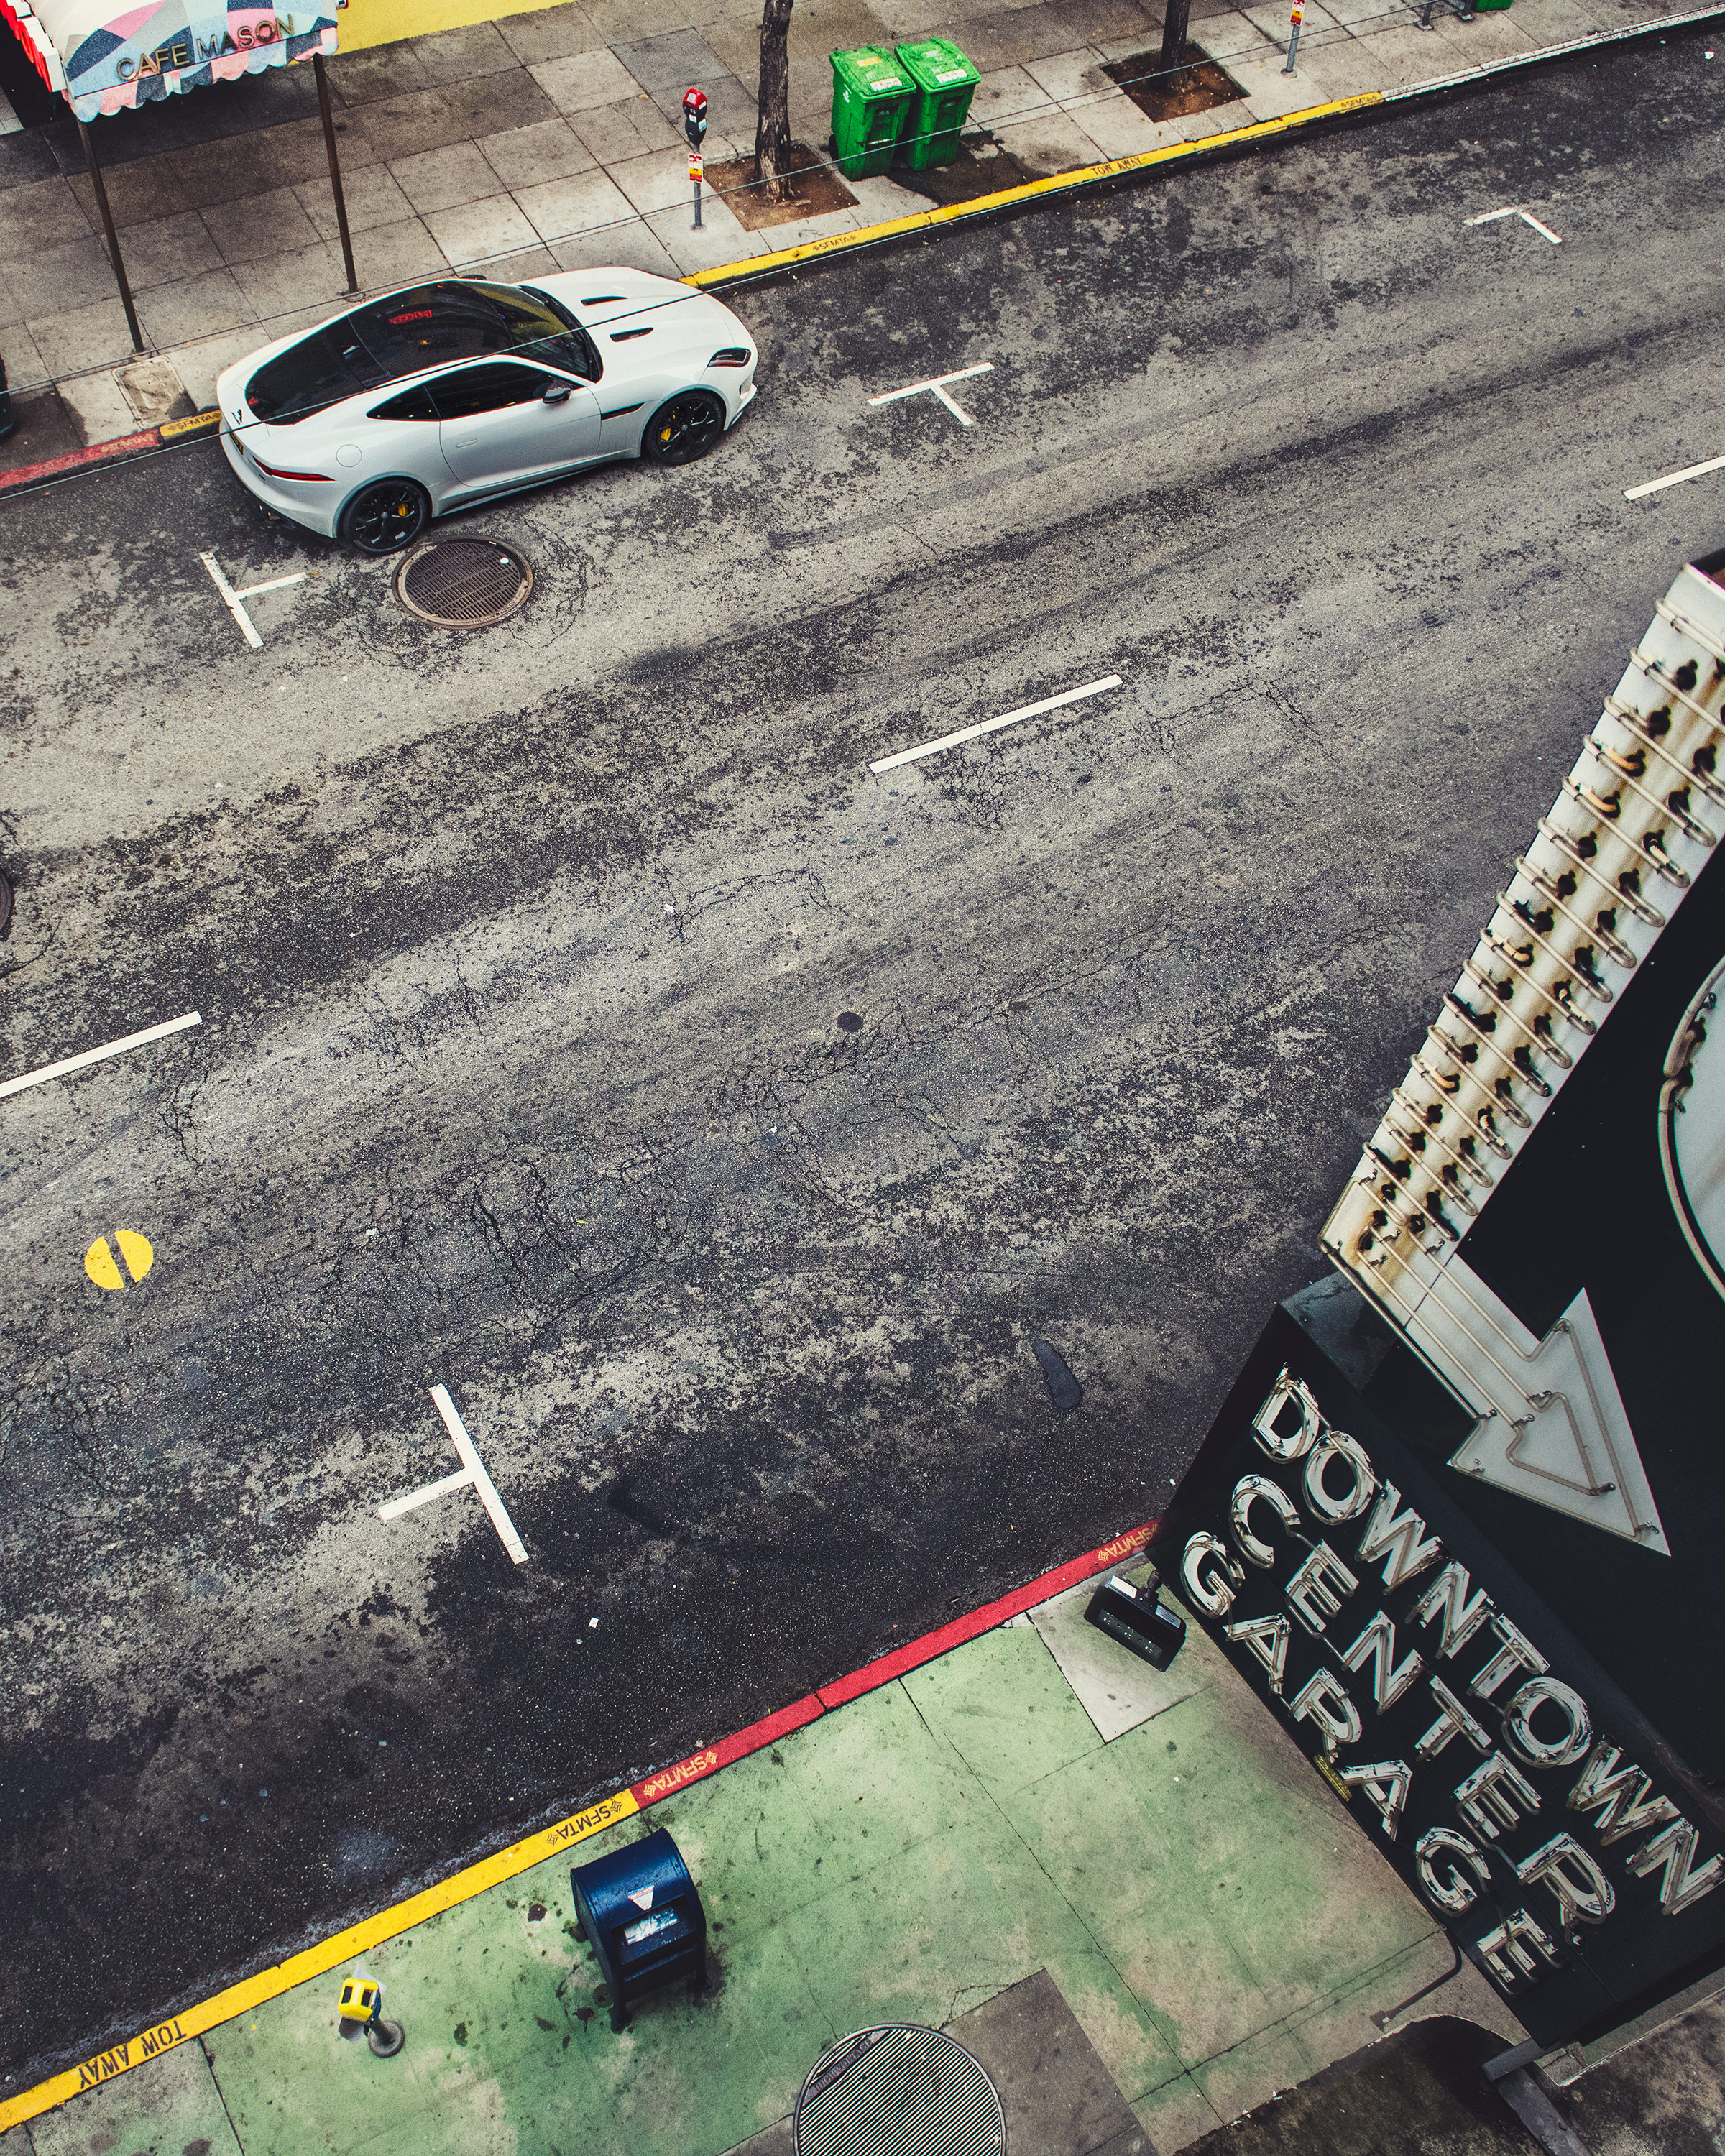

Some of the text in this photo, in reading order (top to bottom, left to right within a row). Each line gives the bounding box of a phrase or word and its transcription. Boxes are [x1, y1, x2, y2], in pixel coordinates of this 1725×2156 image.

[116, 14, 294, 81] CAFE MASON
[1091, 156, 1143, 177] TOW AWAY
[819, 236, 851, 250] SFMTA
[176, 414, 213, 429] SFMTA
[1105, 1527, 1153, 1557] SFMTA
[1251, 1363, 1725, 1915] DOWNTOWN
[1228, 1473, 1616, 1945] CENTER
[652, 1756, 707, 1791] SFMTA
[1179, 1531, 1567, 1998] GARAGE
[556, 1805, 611, 1840] SFMTA
[78, 2020, 187, 2089] TOW AWAY
